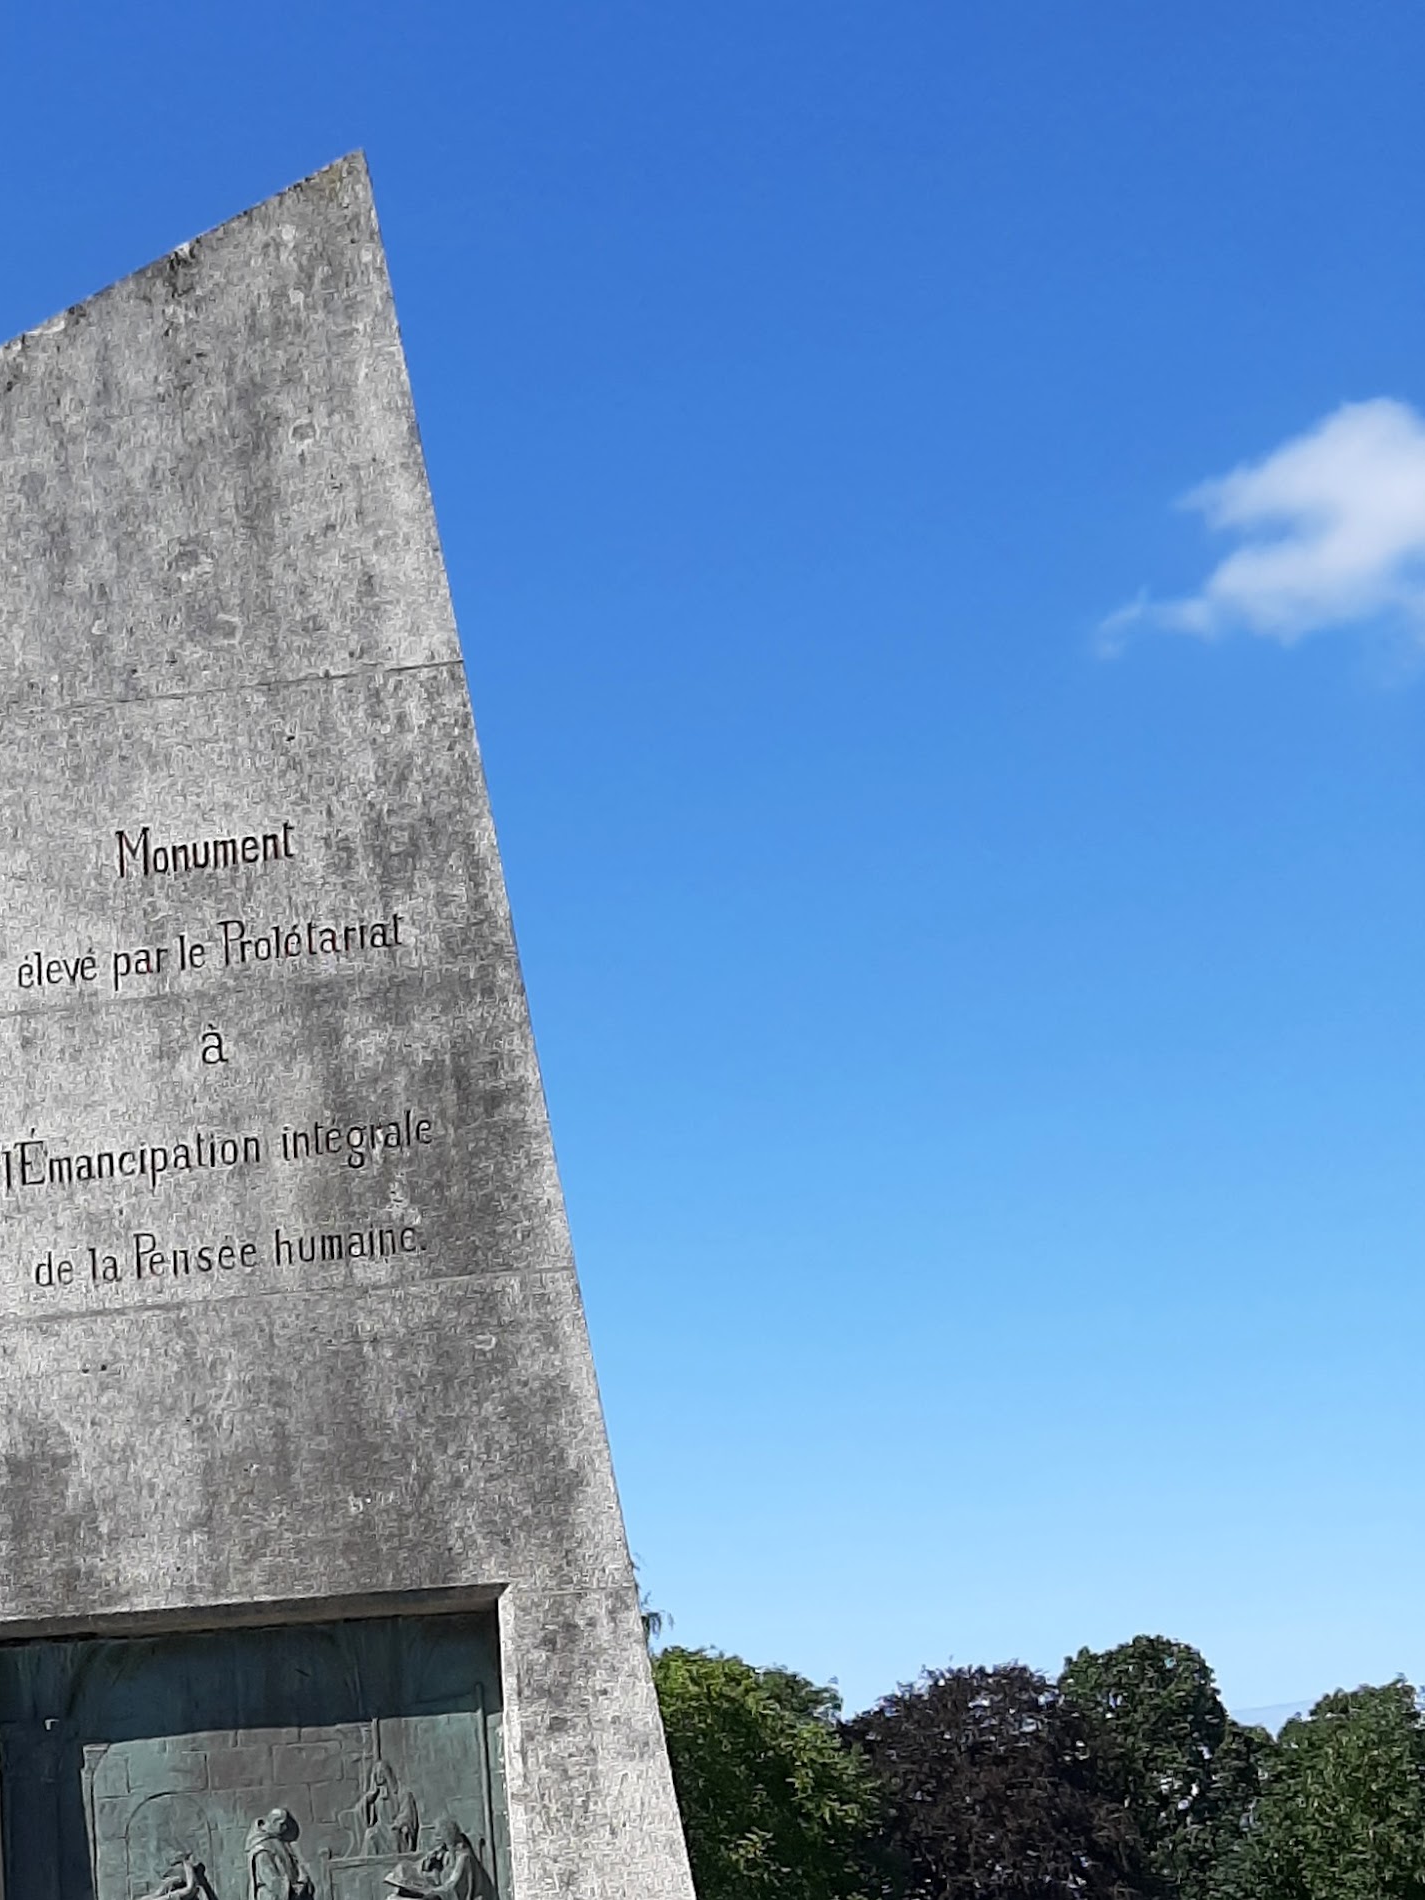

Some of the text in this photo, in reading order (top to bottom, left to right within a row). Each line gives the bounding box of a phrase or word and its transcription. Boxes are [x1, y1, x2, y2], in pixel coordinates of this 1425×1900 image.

[115, 823, 295, 878] Monument
[16, 912, 404, 992] élevé par le Prolétariat
[201, 1024, 229, 1065] à
[281, 1111, 435, 1169] intégrale
[34, 1252, 73, 1287] de
[88, 1247, 121, 1285] la
[132, 1233, 258, 1281] Pensée
